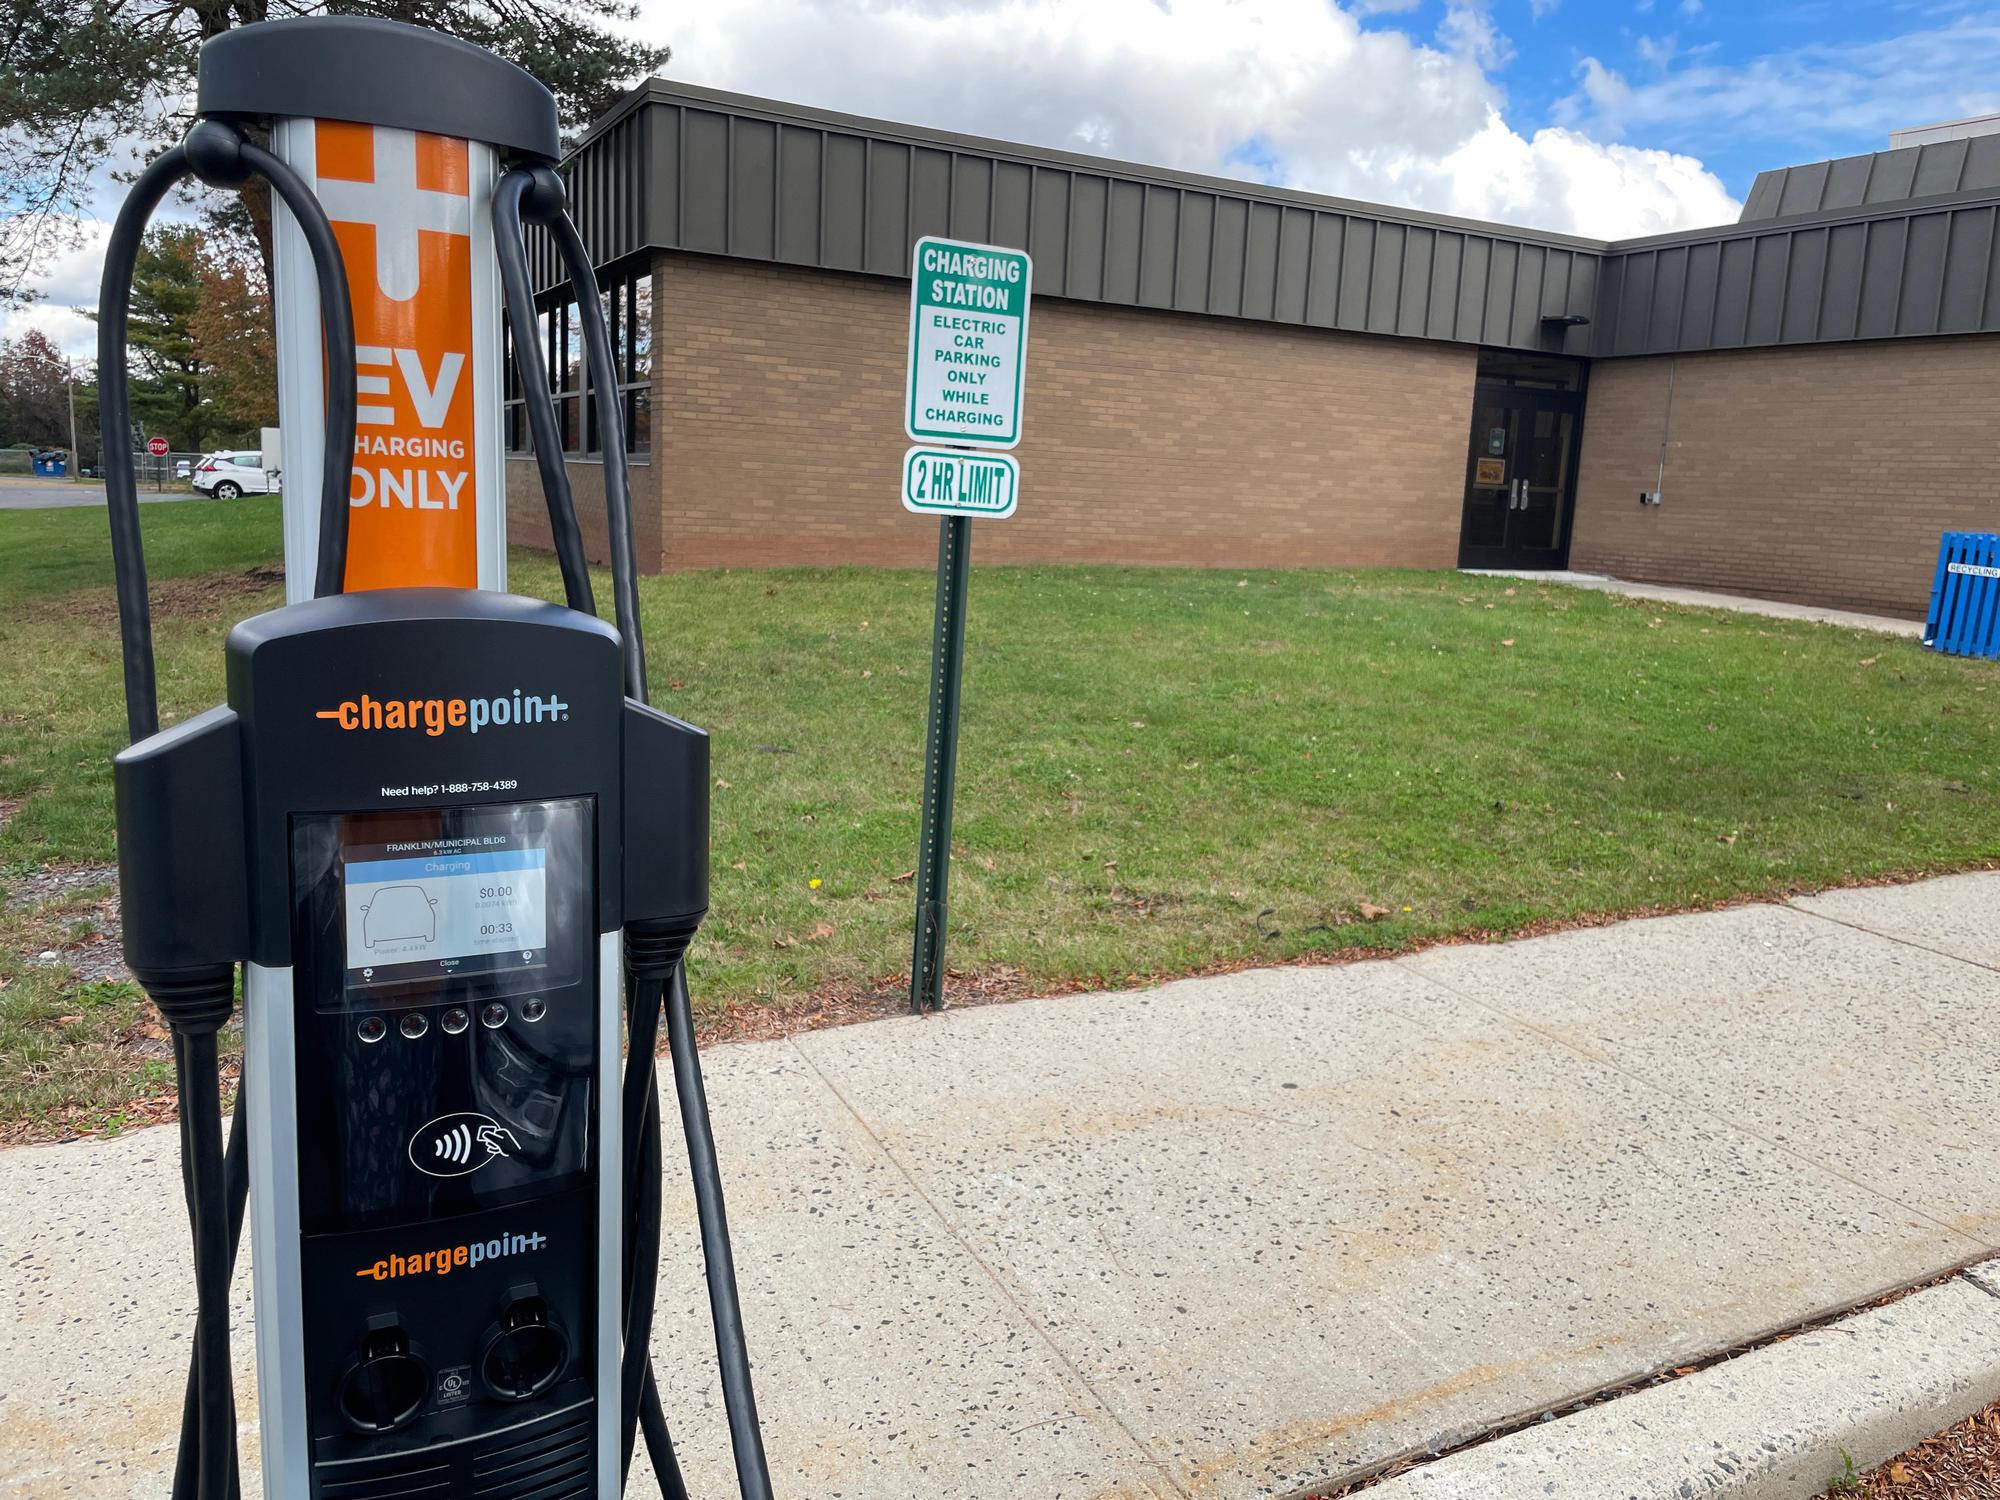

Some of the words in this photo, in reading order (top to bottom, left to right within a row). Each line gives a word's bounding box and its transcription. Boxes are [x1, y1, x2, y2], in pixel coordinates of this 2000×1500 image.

[924, 248, 1020, 283] CHARGING
[931, 279, 1009, 311] STATION
[933, 315, 1006, 335] ELECTRIC
[954, 334, 984, 350] CAR
[935, 349, 1001, 368] PARKING
[355, 345, 466, 429] EV
[947, 370, 987, 386] ONLY
[942, 389, 989, 406] WHILE
[925, 408, 1004, 426] CHARGING
[149, 443, 166, 452] STOP
[354, 434, 464, 458] HARGING
[349, 466, 468, 509] ONLY
[916, 459, 927, 499] 2
[931, 461, 954, 501] HR
[958, 464, 1005, 505] LIMIT
[1950, 565, 1998, 577] RECYCLING
[381, 785, 410, 797] Need
[412, 783, 439, 797] help?
[441, 779, 517, 794] 1-888-758-4389
[386, 839, 482, 853] FRANKLIN/MUNICIPAL
[483, 836, 506, 847] BLDG
[425, 859, 471, 874] Charging
[480, 886, 512, 899] $0.00
[480, 923, 512, 935] 00:33
